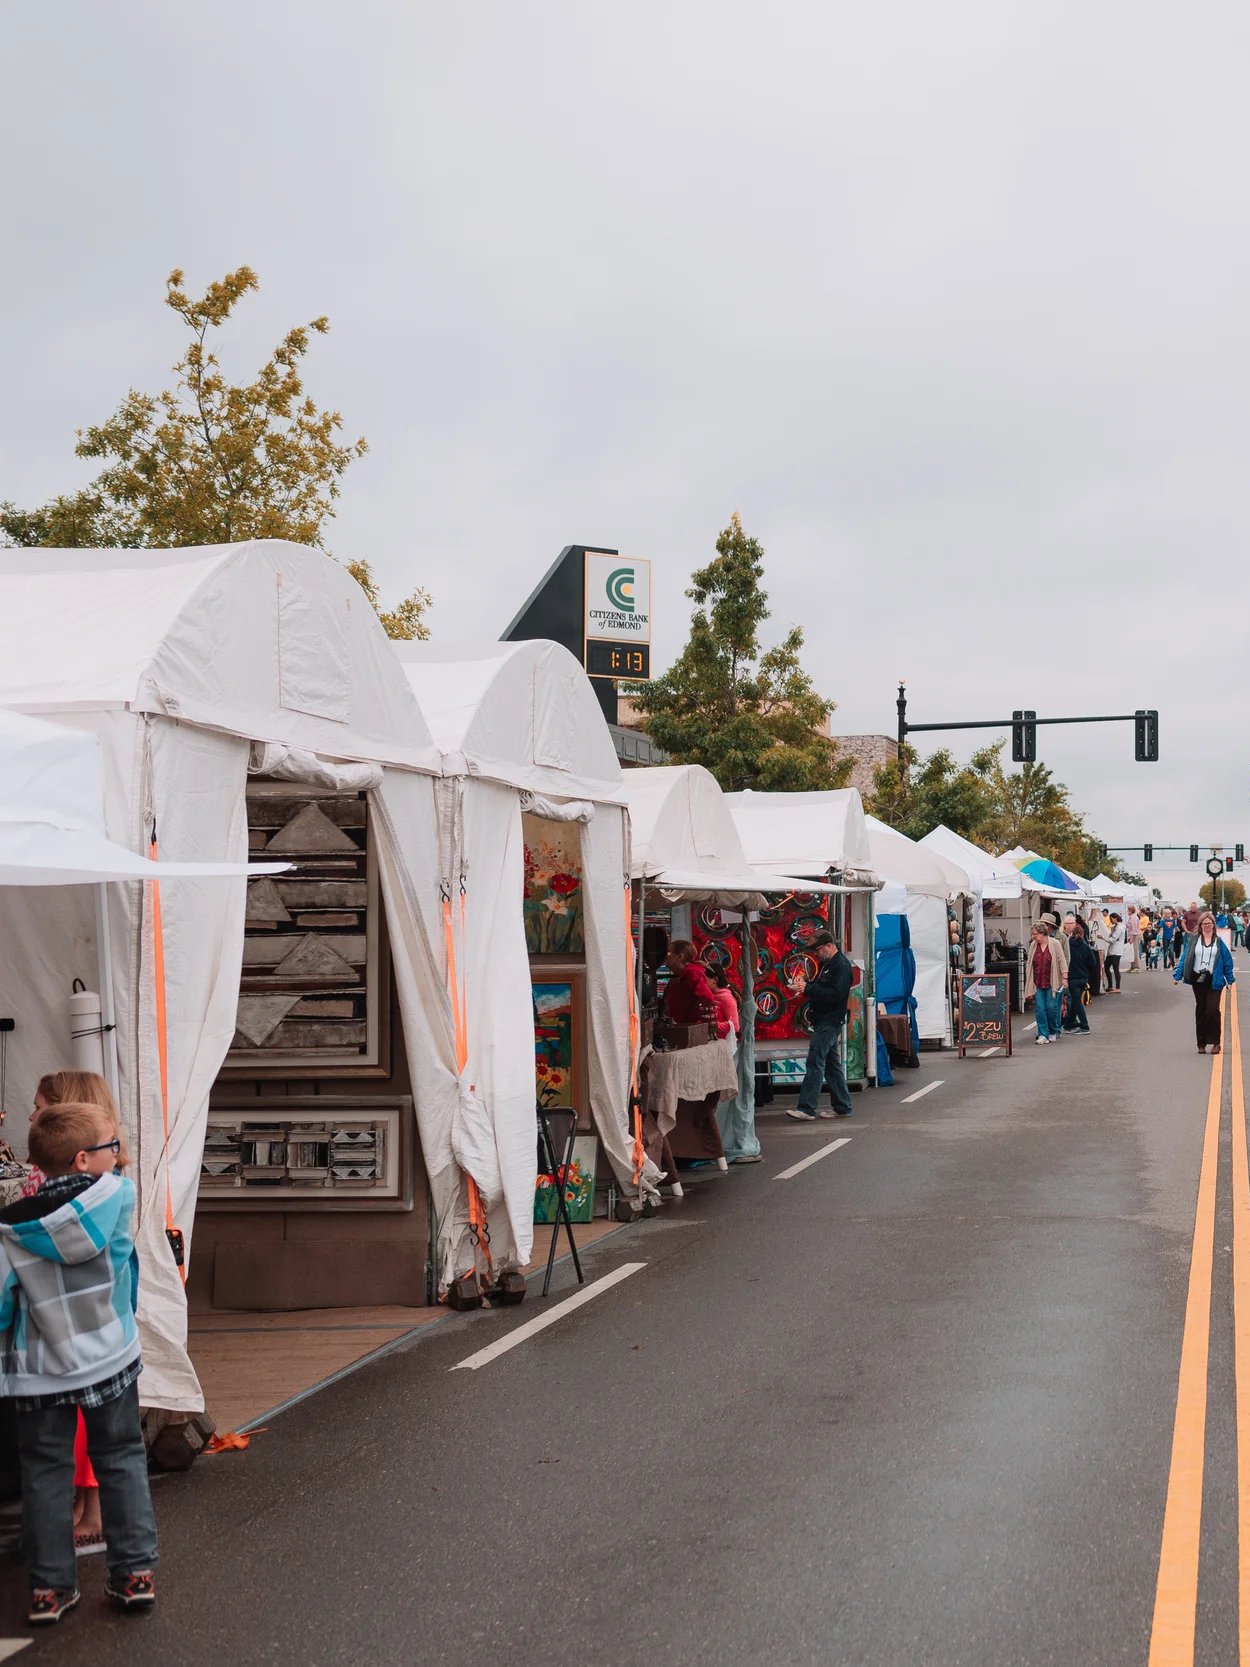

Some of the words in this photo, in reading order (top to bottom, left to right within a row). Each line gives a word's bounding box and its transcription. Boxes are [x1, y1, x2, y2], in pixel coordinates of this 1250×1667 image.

[589, 610, 627, 621] CITIZENS
[628, 613, 649, 623] BANK
[598, 619, 606, 629] of
[608, 620, 642, 630] EDMOND
[611, 651, 643, 672] 1:13
[983, 1021, 1002, 1032] ZU
